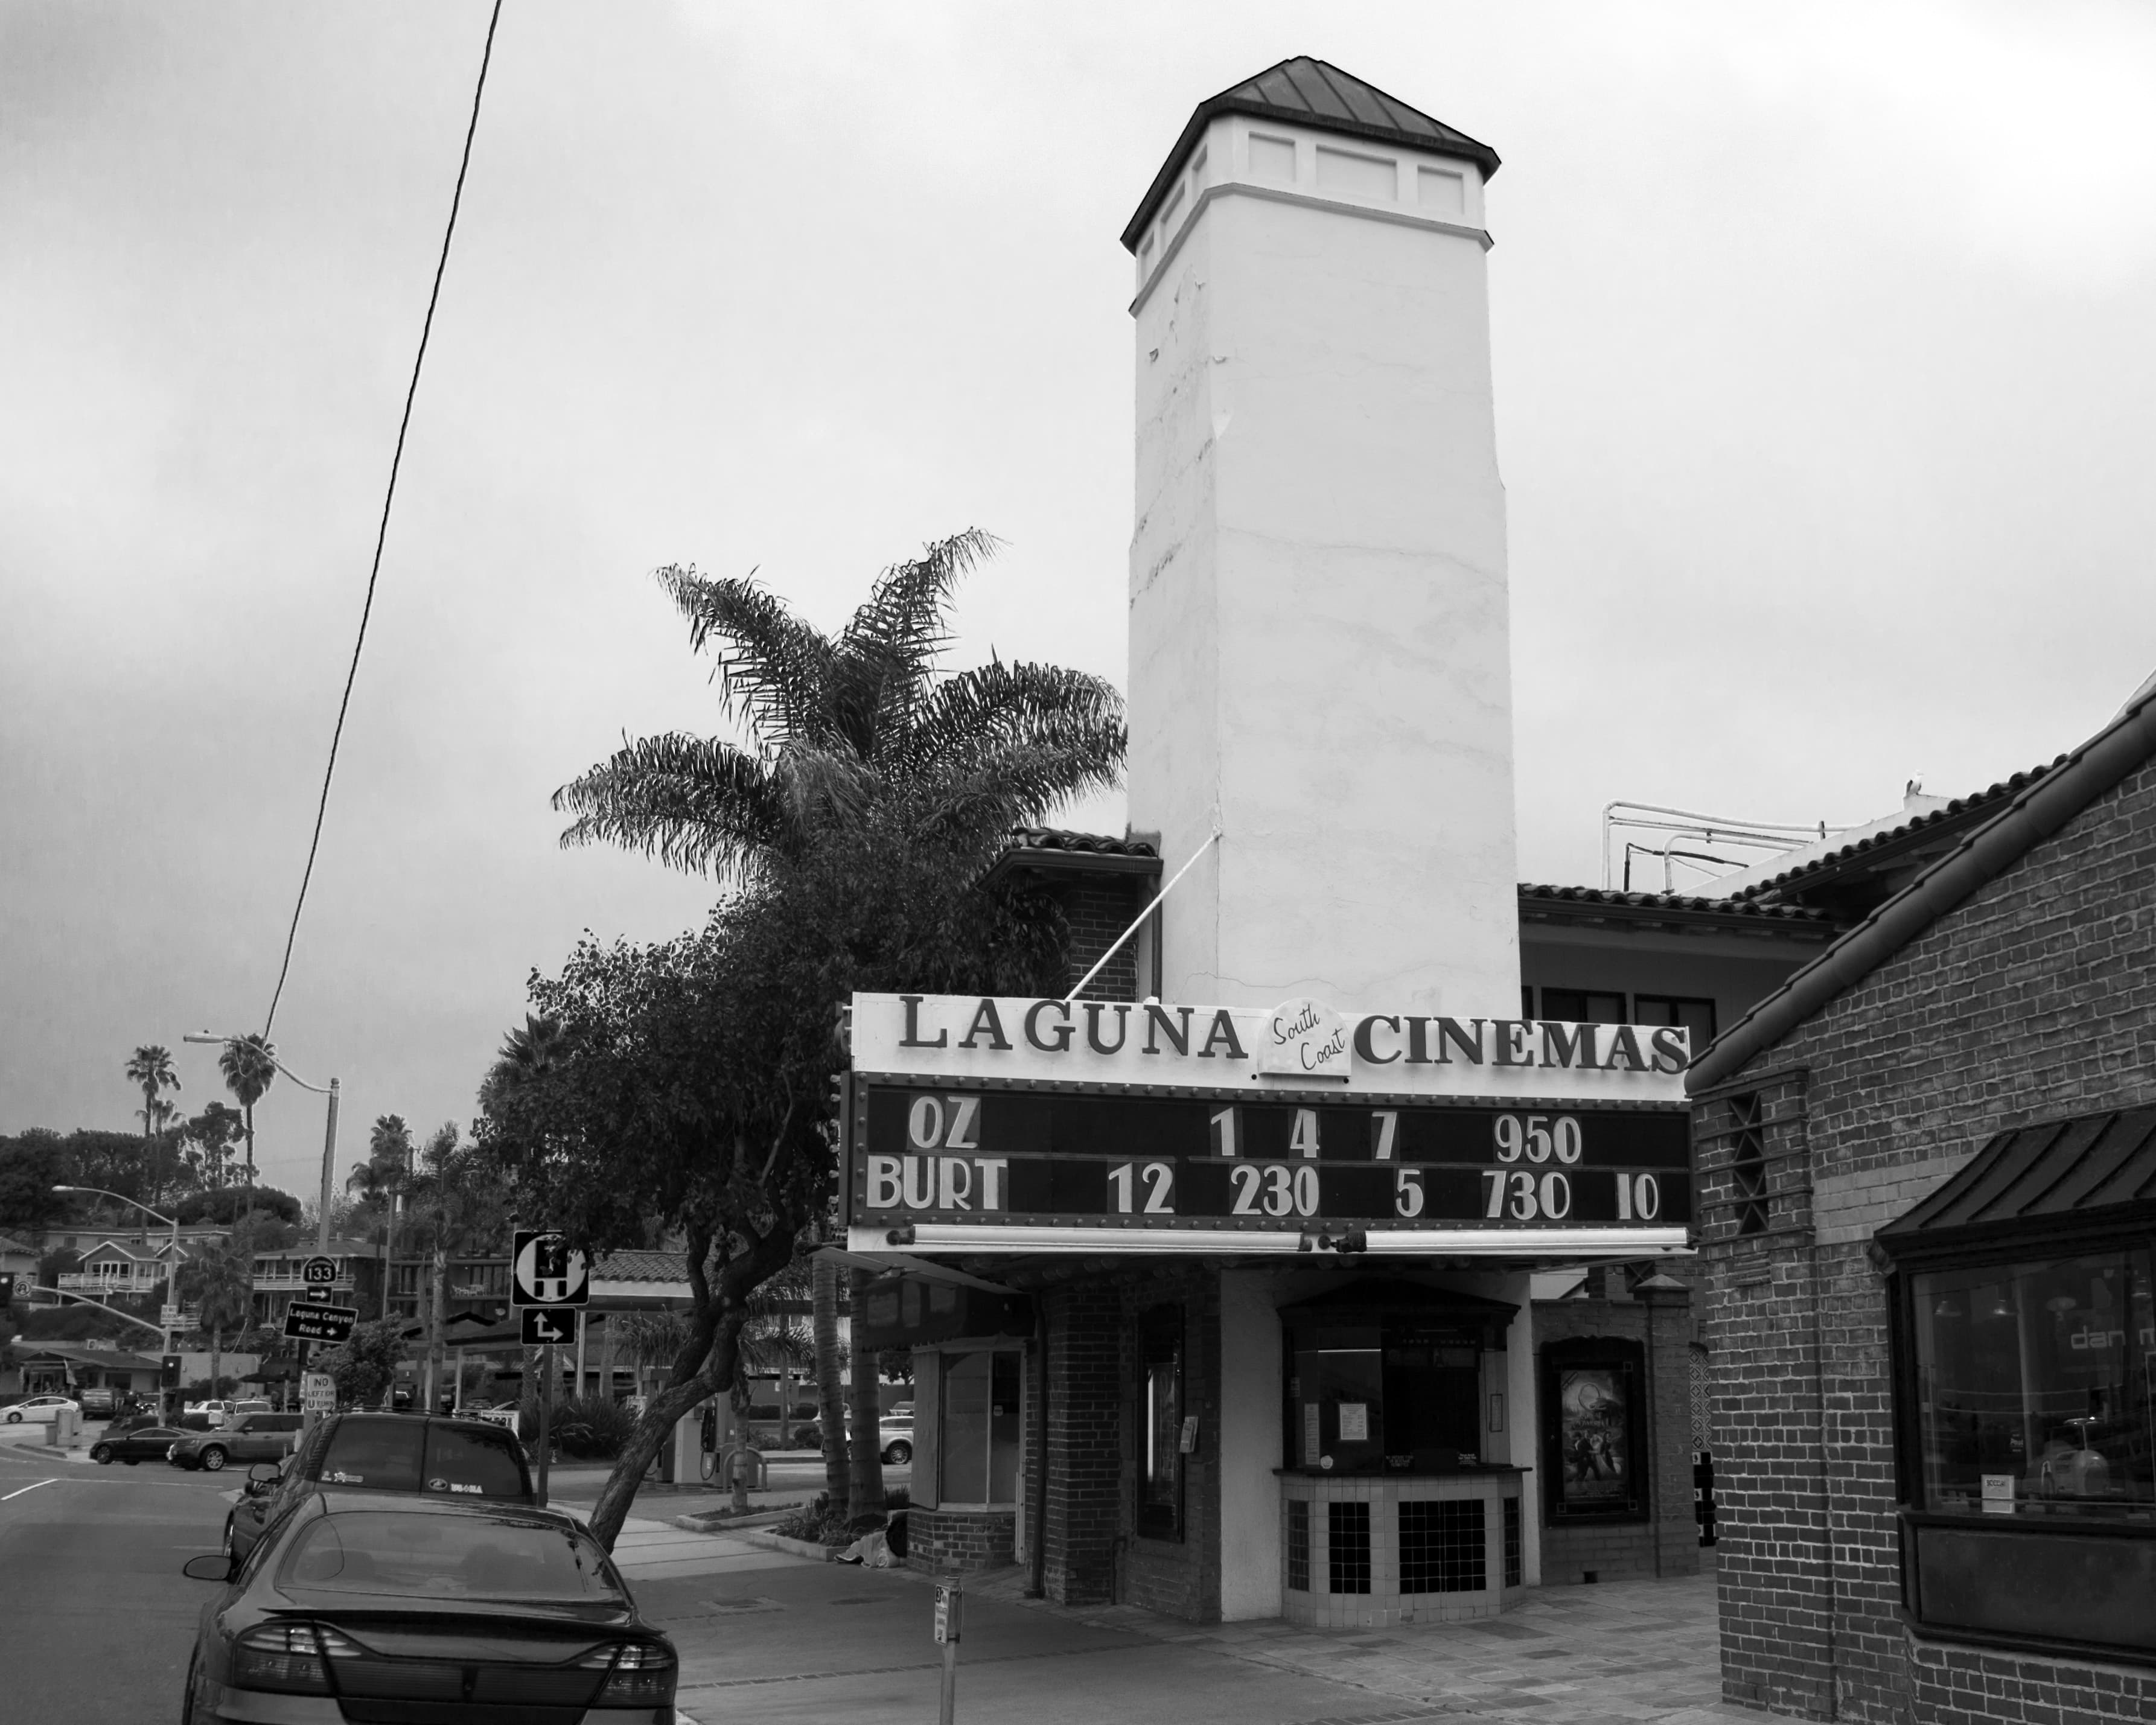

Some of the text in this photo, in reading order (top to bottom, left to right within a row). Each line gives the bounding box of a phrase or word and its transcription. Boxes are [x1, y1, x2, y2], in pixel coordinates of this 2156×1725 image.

[899, 996, 1689, 1074] LAGUNA CINEMAS
[1274, 1003, 1320, 1045] South
[1301, 1027, 1345, 1070] Coast
[909, 1095, 1583, 1164] OZ 1 4 7 950
[867, 1155, 1659, 1220] BURT 12 230 5 730 10
[308, 1267, 332, 1280] 133
[290, 1308, 354, 1324] Laguna Canyon
[299, 1324, 322, 1334] Road
[2071, 1325, 2126, 1350] dan
[314, 1378, 328, 1386] NO
[308, 1400, 315, 1408] U
